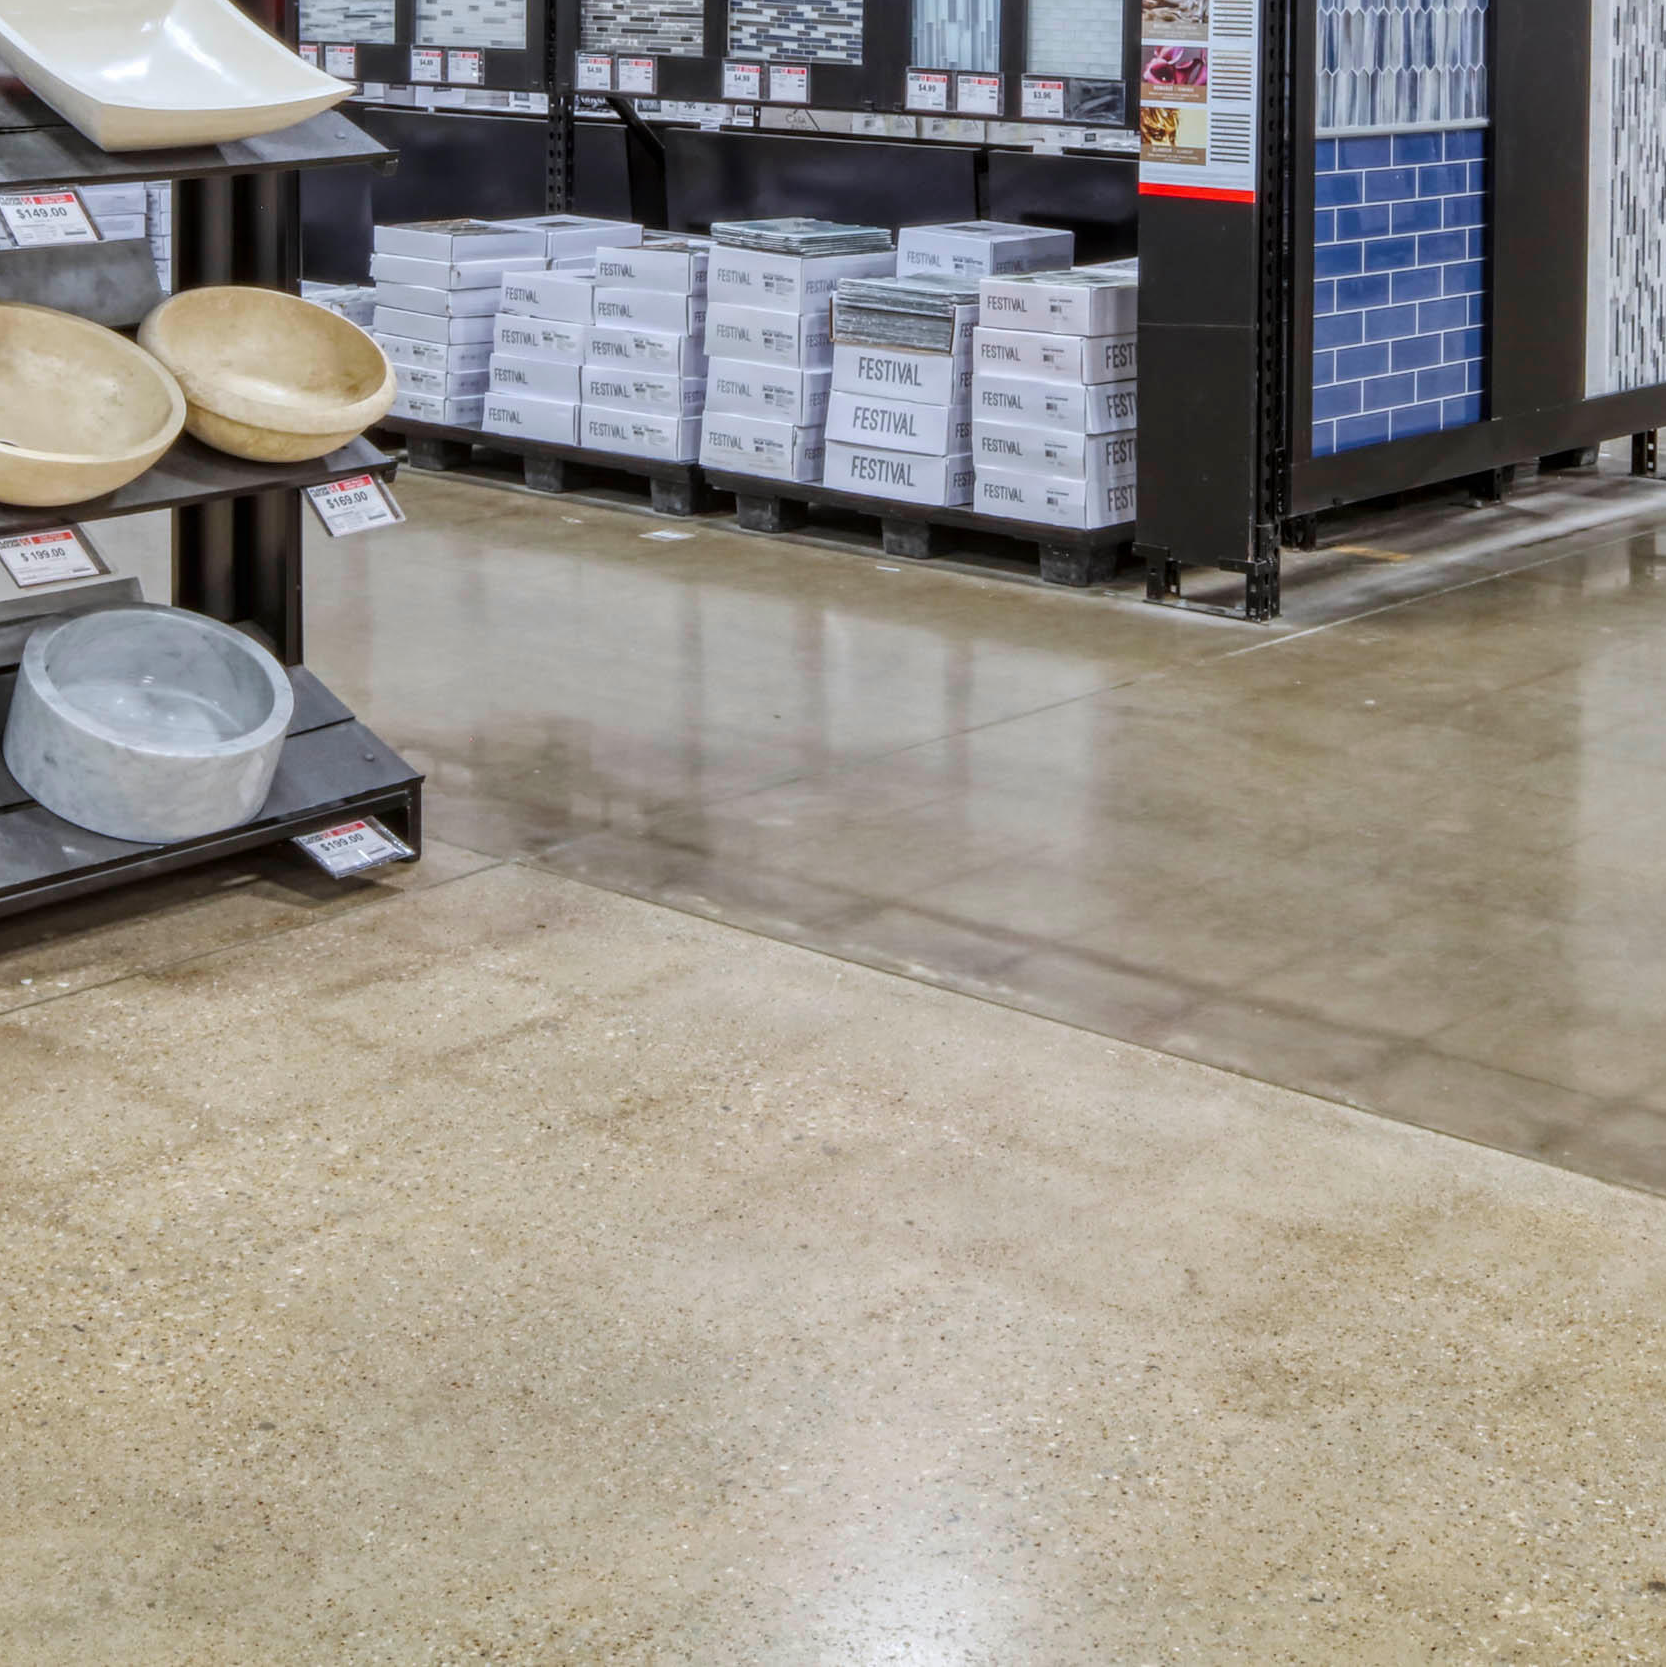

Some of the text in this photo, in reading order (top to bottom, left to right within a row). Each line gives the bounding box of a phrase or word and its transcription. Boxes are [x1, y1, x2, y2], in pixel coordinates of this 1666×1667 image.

[16, 207, 67, 219] $149.00
[906, 250, 942, 267] FESTIVAL
[600, 262, 635, 278] FESTIVAL
[717, 268, 752, 285] FESTIVAL
[505, 286, 539, 304] FESTIVAL
[987, 295, 1027, 312] FESTIVAL
[598, 302, 632, 318] FESTIVAL
[501, 329, 538, 346] FESTIVAL
[716, 324, 752, 342] FESTIVAL
[592, 341, 630, 358] FESTIVAL
[981, 344, 1021, 361] FESTIVAL
[1106, 343, 1134, 369] FEST
[494, 367, 528, 384] FESTIVAL
[858, 356, 922, 386] FESTIVAL
[590, 381, 630, 398] FESTIVAL
[716, 379, 752, 397] FESTIVAL
[982, 391, 1023, 410] FESTIVAL
[1106, 392, 1134, 418] FEST
[488, 407, 523, 424] FESTIVAL
[852, 406, 917, 436] FESTIVAL
[589, 422, 628, 439] FESTIVAL
[709, 432, 743, 450] FESTIVAL
[982, 437, 1023, 456] FESTIVAL
[1106, 438, 1134, 465] FEST
[851, 455, 915, 486] FESTIVAL
[326, 491, 368, 509] $169.00
[983, 484, 1025, 502] FESTIVAL
[1108, 485, 1134, 512] FEST
[21, 547, 66, 562] $ 199.00
[320, 833, 364, 851] $199.00
